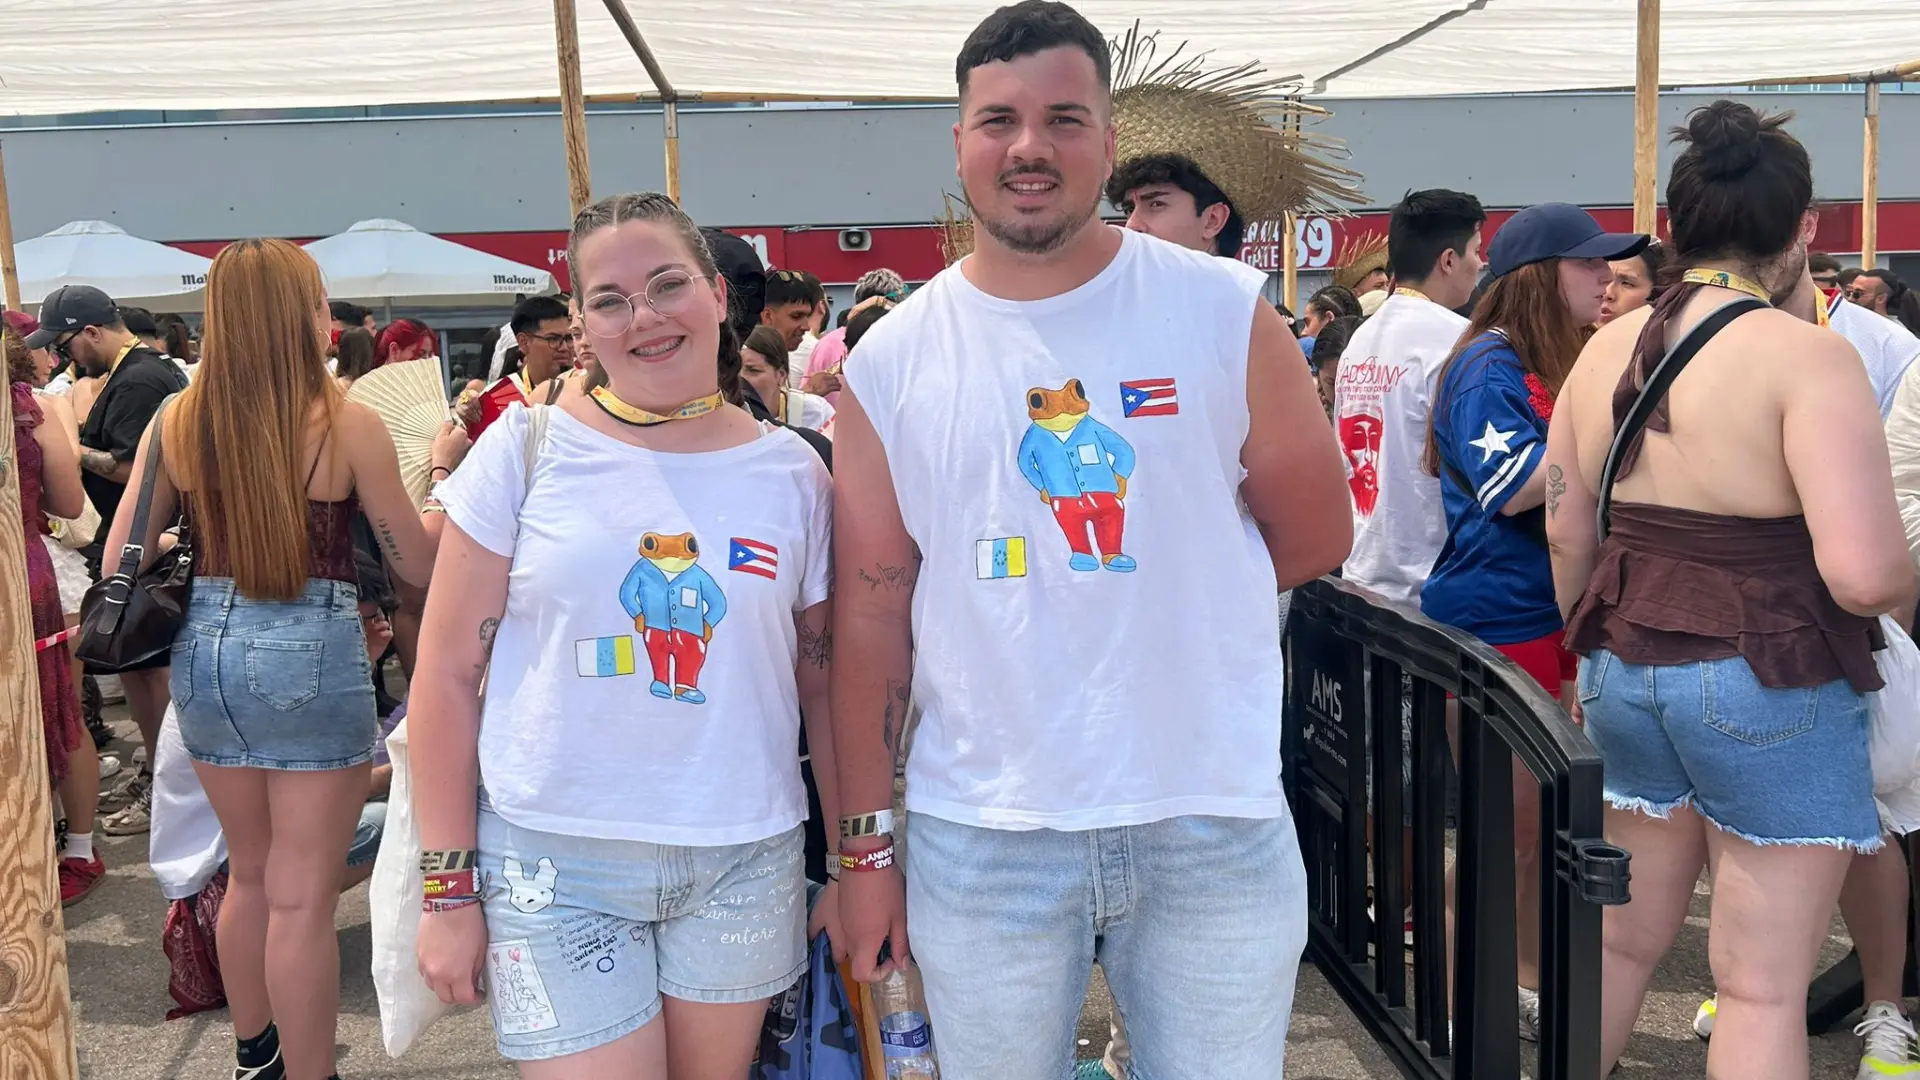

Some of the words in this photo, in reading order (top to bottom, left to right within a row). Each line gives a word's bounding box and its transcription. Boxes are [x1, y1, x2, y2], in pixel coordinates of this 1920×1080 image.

[1241, 245, 1279, 268] GATE
[493, 275, 536, 284] Mahou
[1311, 668, 1342, 723] AMS
[874, 856, 892, 869] BAD
[578, 937, 601, 950] NUNCA
[720, 926, 778, 945] entero
